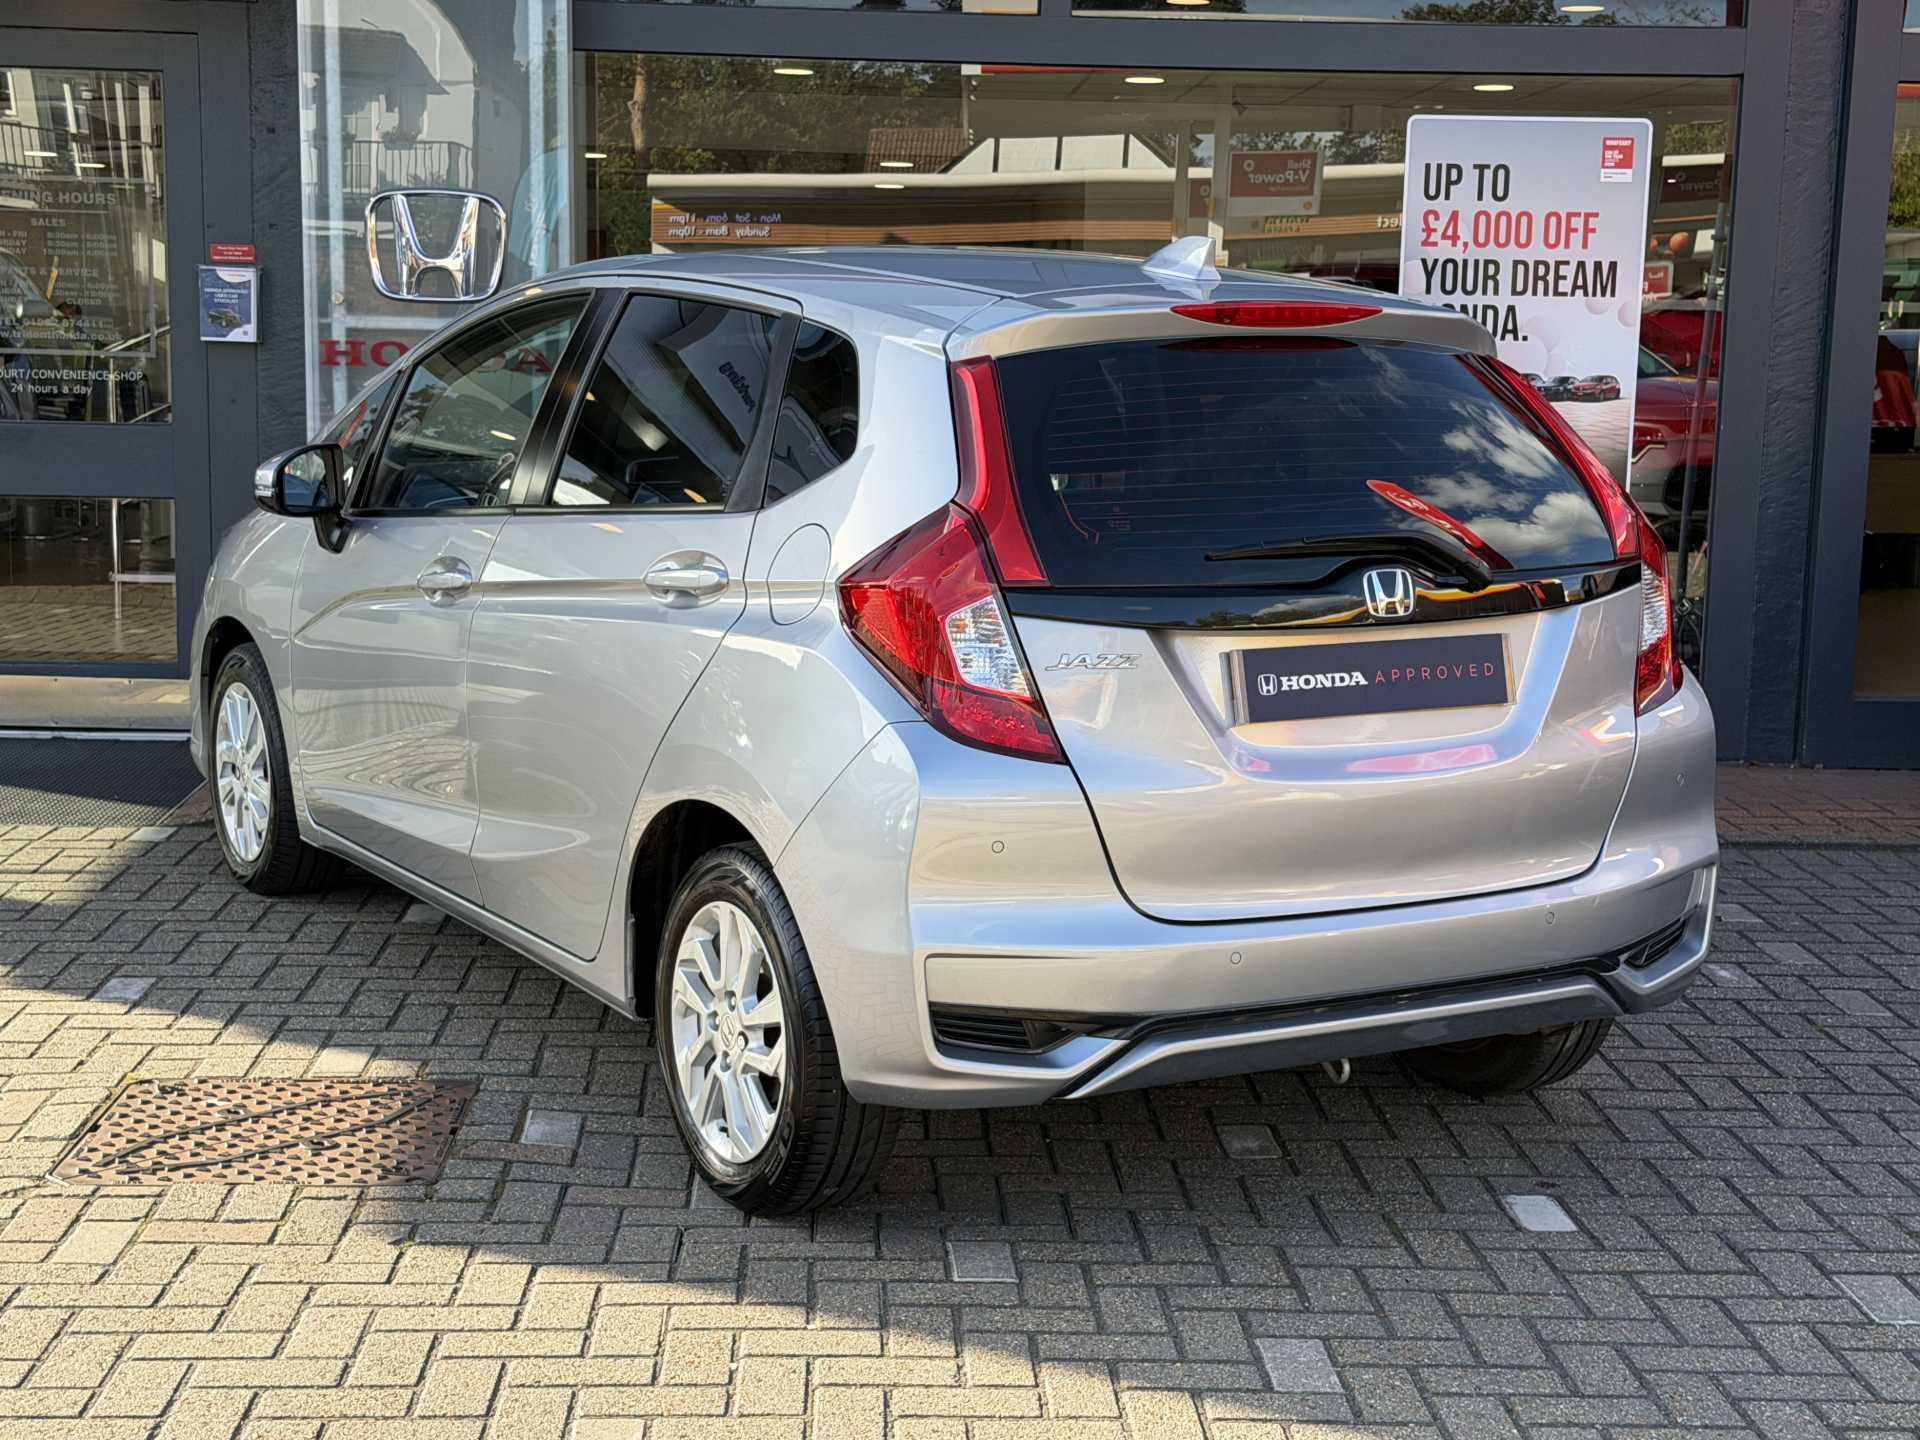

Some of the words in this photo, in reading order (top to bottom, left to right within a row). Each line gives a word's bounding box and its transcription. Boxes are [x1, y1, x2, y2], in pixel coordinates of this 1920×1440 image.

[1424, 163, 1463, 201] UP
[1473, 163, 1511, 202] TO
[58, 191, 116, 206] HOURS
[30, 217, 66, 227] SALES
[1420, 209, 1533, 254] £4,000
[1543, 211, 1600, 249] OFF
[1421, 258, 1500, 296] YOUR
[1511, 260, 1618, 298] DREAM
[32, 368, 109, 381] CONVENIENCE
[113, 370, 144, 382] SHOP
[11, 382, 23, 393] 24
[28, 383, 58, 394] hours
[62, 385, 69, 394] a
[73, 384, 93, 397] day
[1044, 653, 1142, 671] JAZZ
[1280, 671, 1369, 691] HONDA
[1375, 662, 1494, 684] APPROVED
